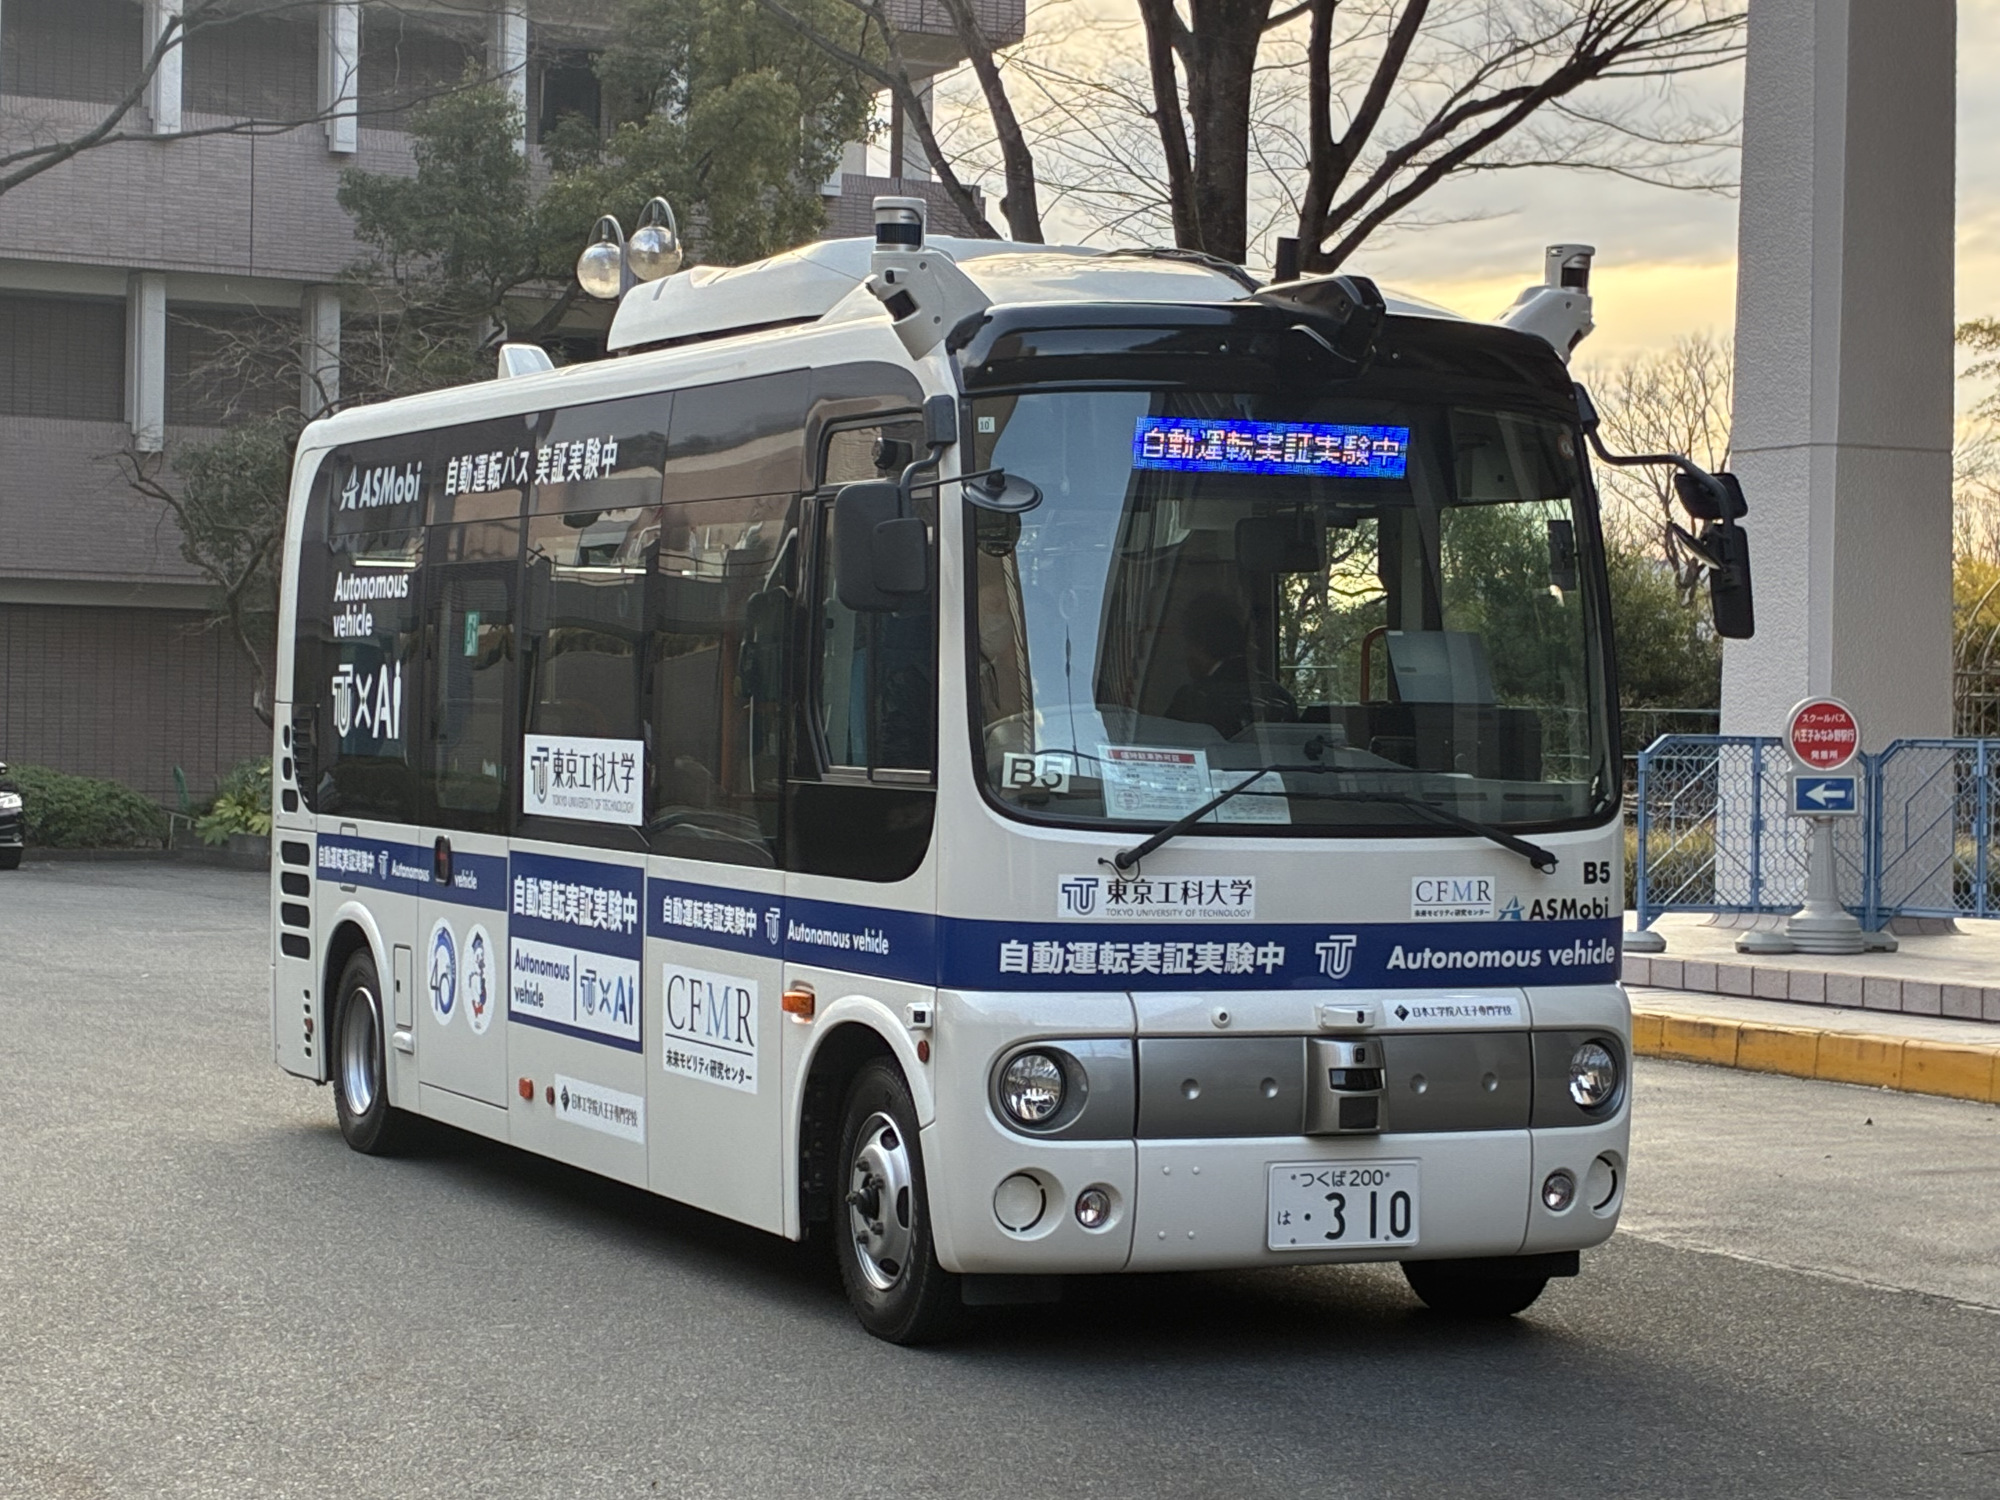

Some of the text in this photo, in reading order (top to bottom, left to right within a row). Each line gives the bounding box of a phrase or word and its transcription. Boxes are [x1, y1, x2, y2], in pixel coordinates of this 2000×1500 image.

[1142, 427, 1399, 467] 自動運転実証実験中
[445, 435, 618, 496] 自動運転バス 実証実験中
[359, 462, 422, 509] ASMobi
[333, 571, 409, 603] Autonomous
[332, 602, 373, 638] vehicle
[1801, 713, 1847, 723] スクールバス
[552, 747, 635, 794] 東京工科大学
[1010, 757, 1063, 789] B5
[391, 858, 430, 883] Autonomous
[454, 869, 478, 890] vehicle
[1583, 861, 1611, 884] B5
[513, 875, 638, 934] 自動運転実証実験中
[1106, 878, 1253, 905] 東京工科大学
[1415, 880, 1492, 902] CFMR
[1106, 908, 1251, 918] TOKYO UNIVERSITY OF TECHNOLOGY
[1529, 897, 1609, 920] ASMobi
[662, 895, 757, 938] 自動運転実証実験中
[787, 919, 850, 949] Autonomous
[852, 927, 889, 955] vehicle
[514, 948, 570, 981] Autonomous
[999, 940, 1285, 975] 自動運転実証実験中
[1386, 945, 1541, 970] Autonomous
[1549, 937, 1615, 966] vehicle
[513, 979, 544, 1008] vehicle
[667, 974, 755, 1047] CFMR
[665, 1049, 752, 1084] 未来モビリティ研究センター
[1277, 1210, 1291, 1226] は
